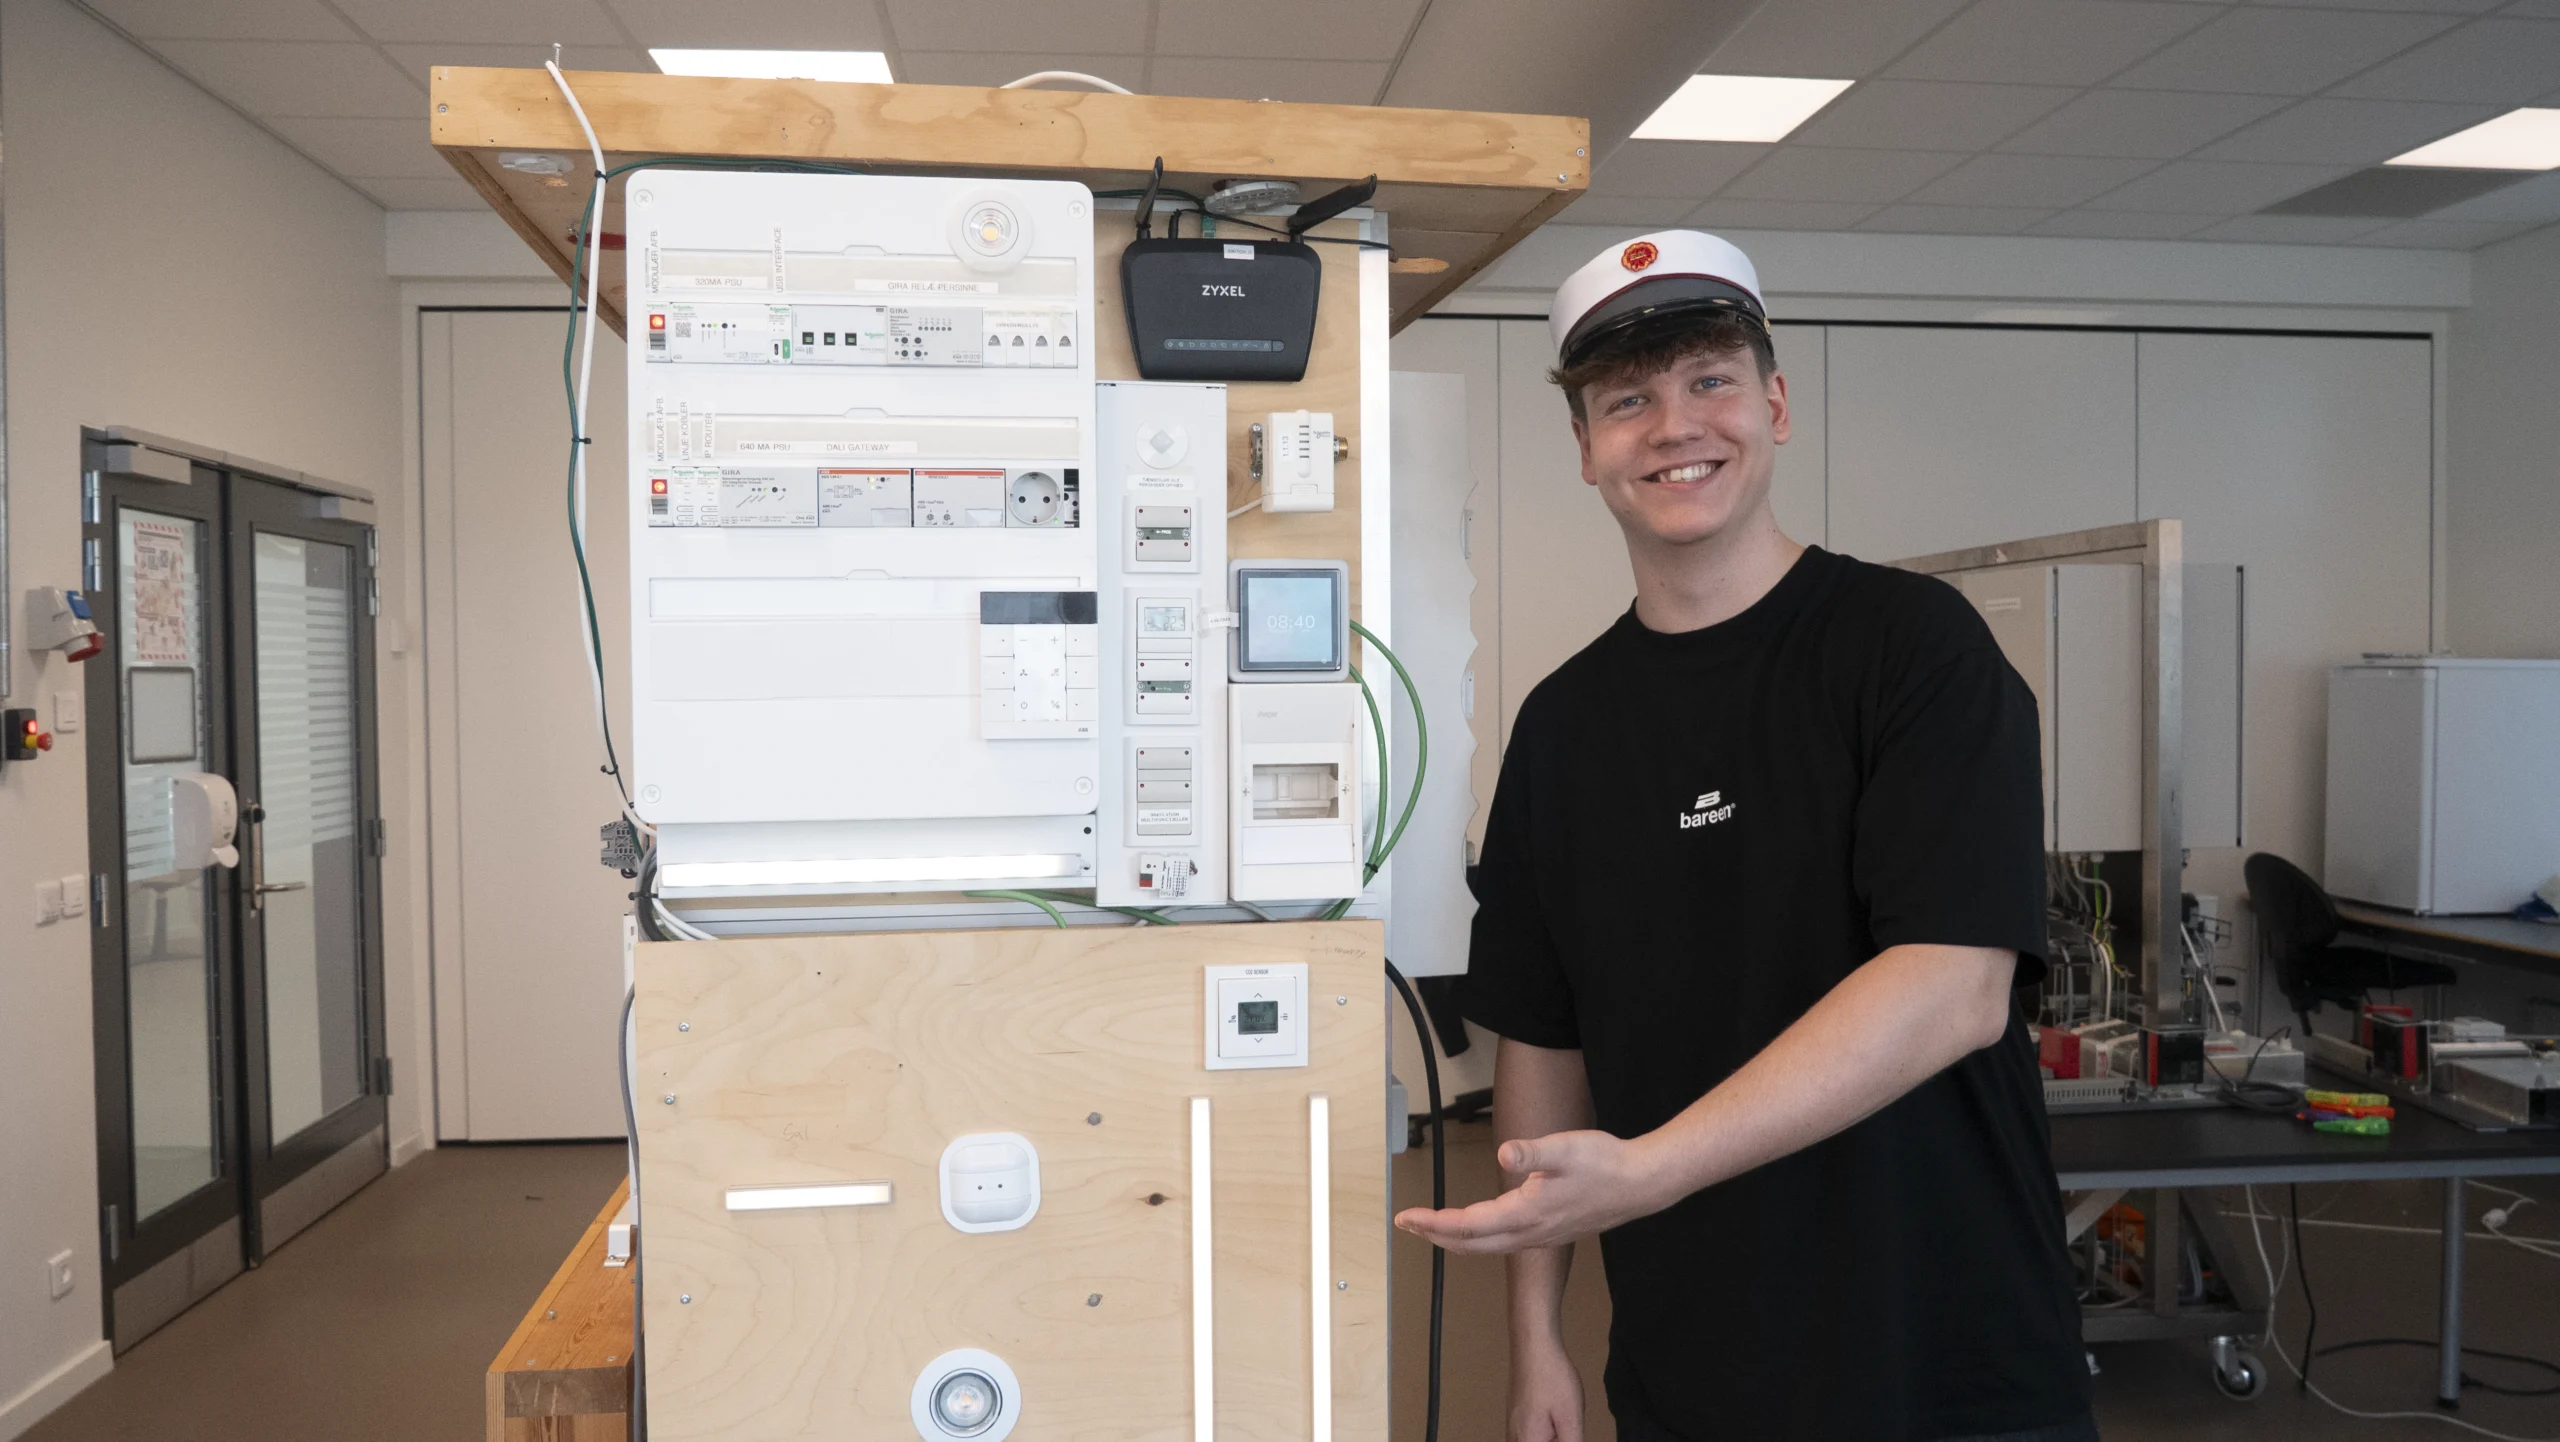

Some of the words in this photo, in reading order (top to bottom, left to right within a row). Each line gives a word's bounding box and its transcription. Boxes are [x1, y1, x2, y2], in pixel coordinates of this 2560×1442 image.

[773, 227, 783, 273] INTERFACE
[650, 250, 660, 294] MODULÆR
[775, 275, 784, 293] USB
[887, 282, 909, 290] GIRA
[911, 282, 935, 291] RELÆ
[1202, 285, 1246, 297] ZYXEL
[680, 401, 689, 436] KOBLER
[704, 412, 713, 447] ROUTER
[656, 417, 665, 462] MODULÆR
[681, 438, 690, 460] LINJE
[740, 443, 755, 451] 640
[757, 443, 771, 451] MA
[826, 443, 847, 451] DALI
[1266, 614, 1316, 629] 08:40
[1680, 804, 1732, 829] bareen
